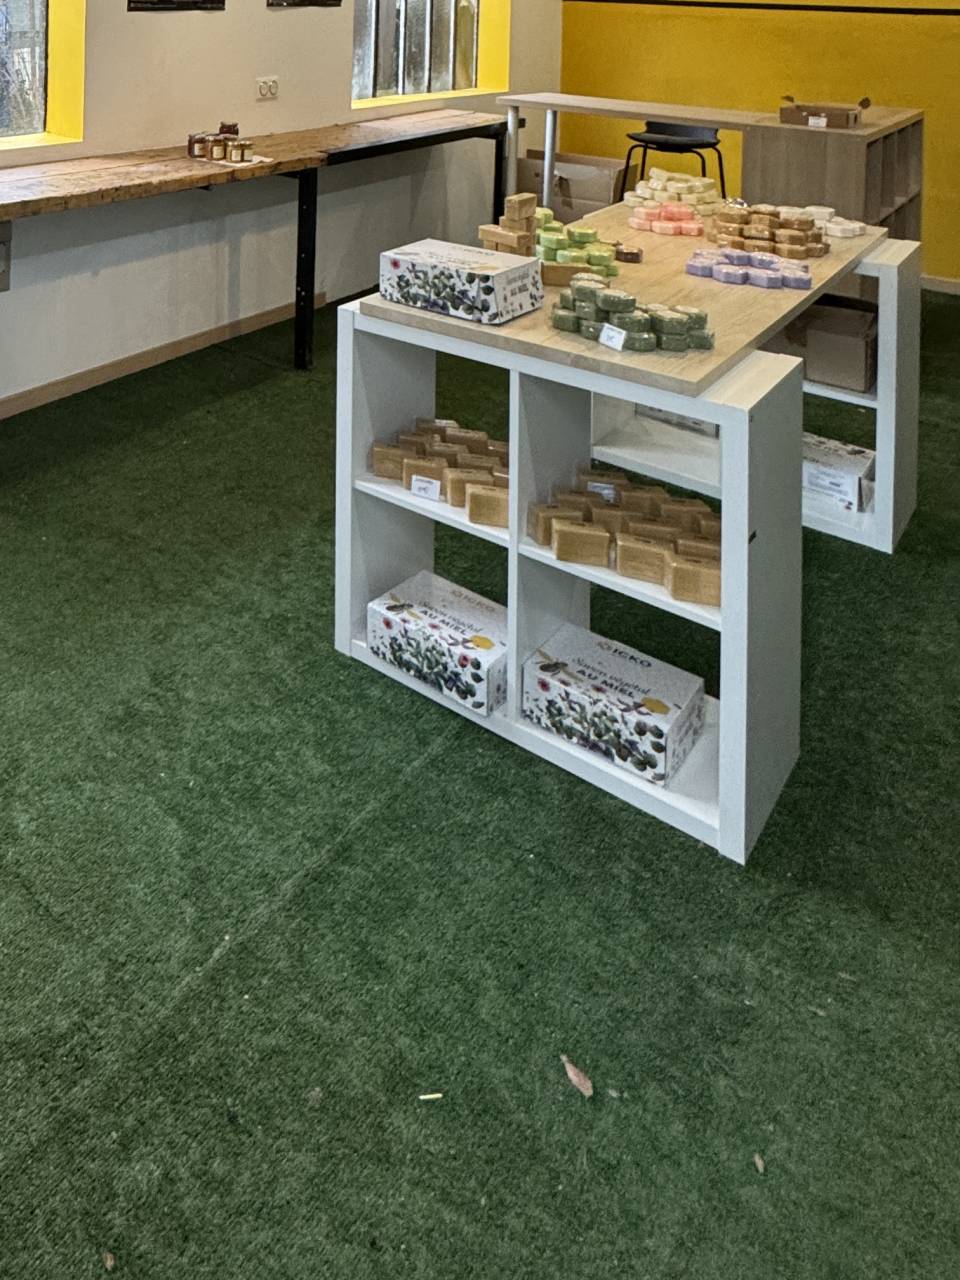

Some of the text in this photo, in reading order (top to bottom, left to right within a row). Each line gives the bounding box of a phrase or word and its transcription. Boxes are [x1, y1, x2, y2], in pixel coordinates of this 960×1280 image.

[419, 610, 467, 635] AU MIEL
[611, 648, 652, 668] ICKO
[576, 669, 635, 698] AU MIEL
